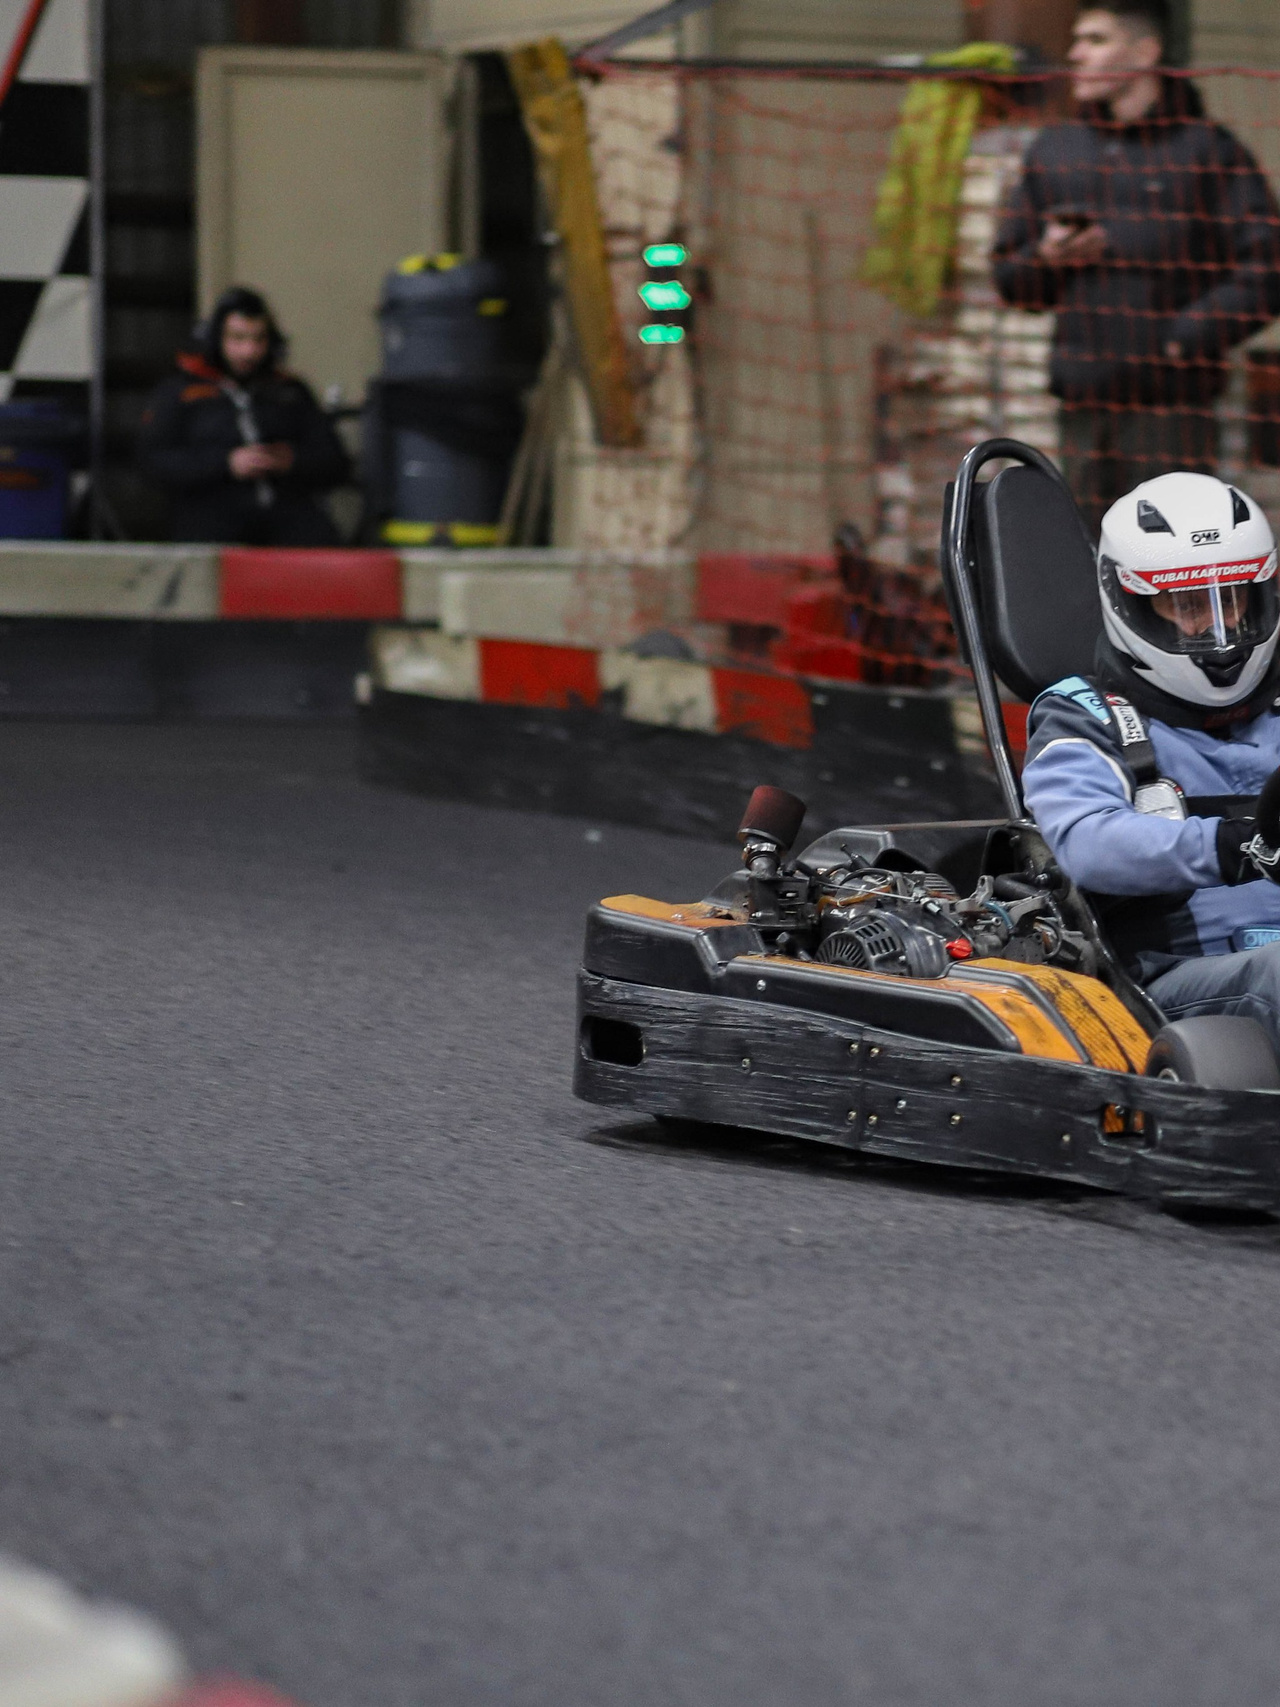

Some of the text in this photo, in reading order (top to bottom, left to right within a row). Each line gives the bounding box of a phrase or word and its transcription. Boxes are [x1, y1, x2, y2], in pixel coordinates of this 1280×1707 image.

[1191, 531, 1220, 544] OMP
[1151, 563, 1260, 584] DUBAI KARTDROME
